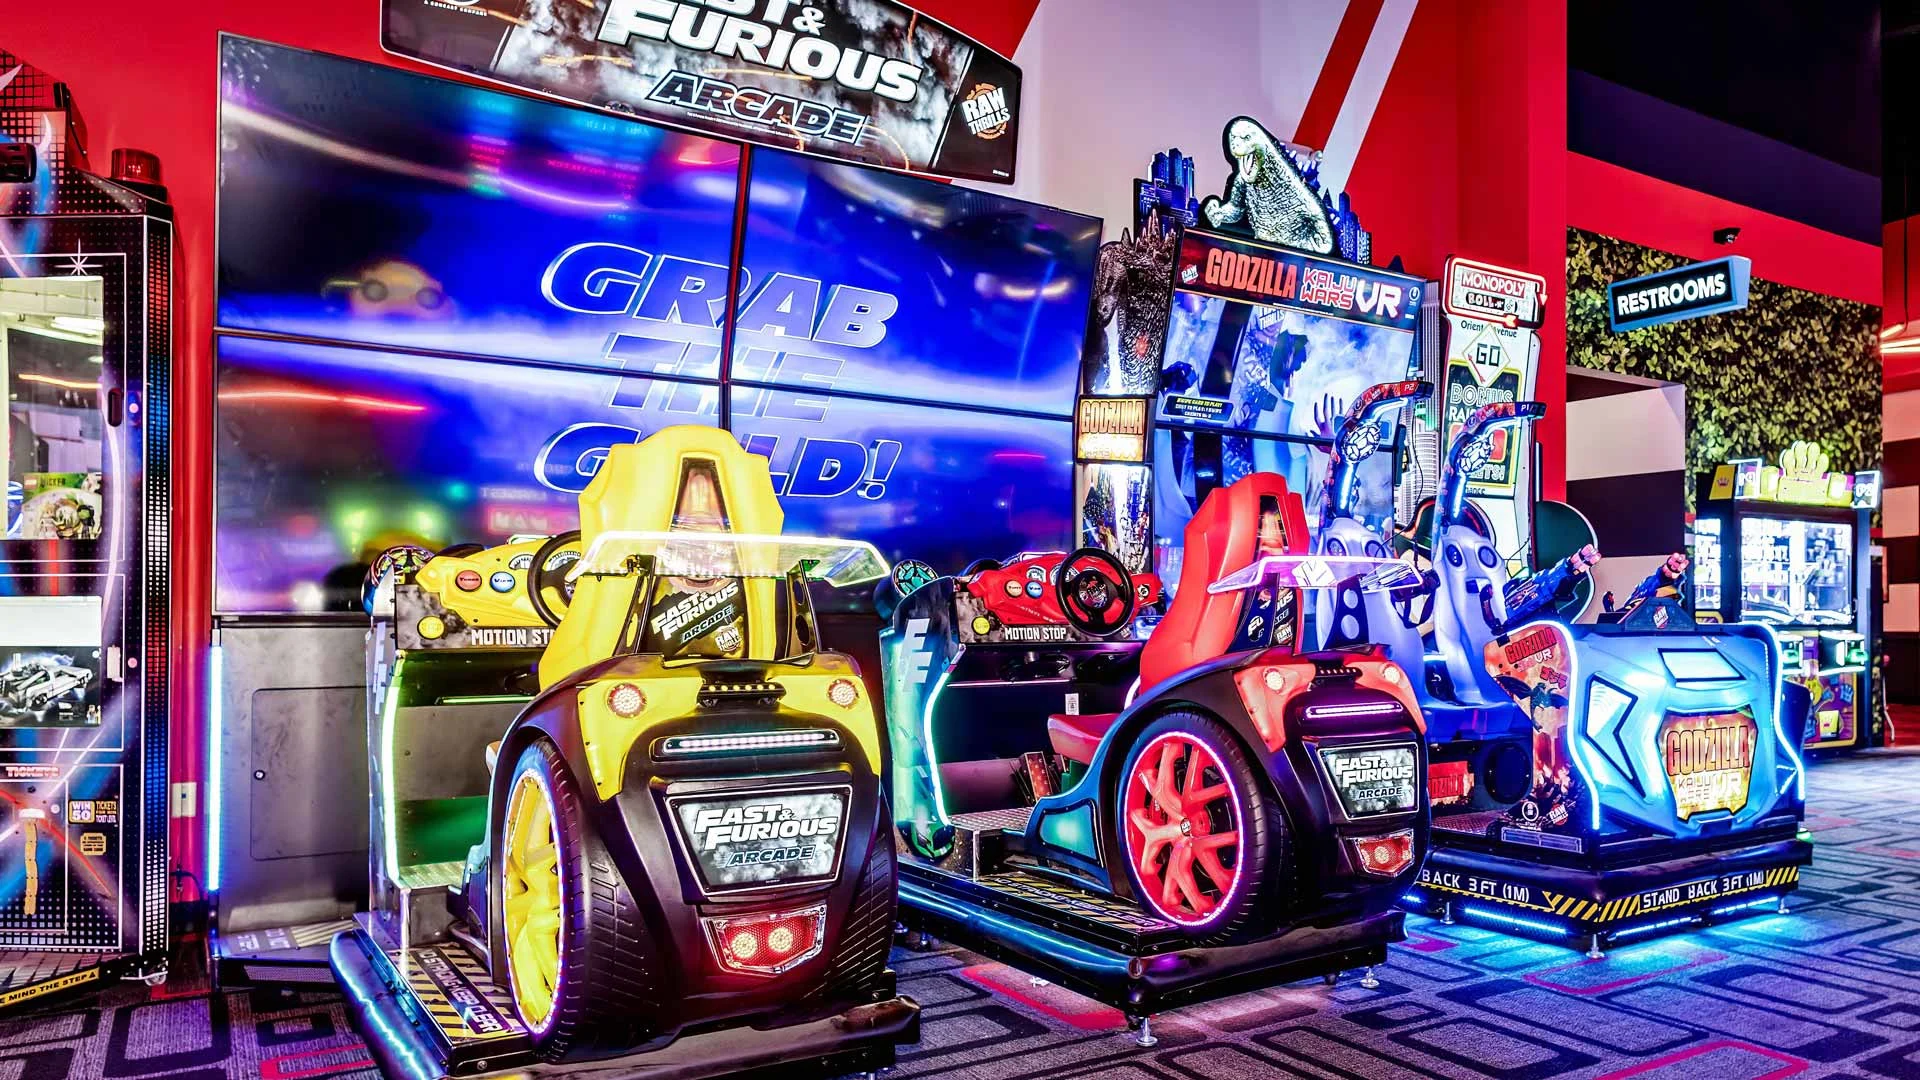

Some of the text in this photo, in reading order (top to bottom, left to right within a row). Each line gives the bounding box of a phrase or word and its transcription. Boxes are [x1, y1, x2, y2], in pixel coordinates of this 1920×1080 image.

[597, 0, 922, 103] FURIOUS
[648, 71, 866, 145] ARCADE
[962, 87, 1006, 122] RAW
[967, 107, 1011, 135] THRILLS
[1205, 247, 1298, 299] GODZILLA
[1303, 267, 1357, 294] KAIJU
[1462, 270, 1526, 298] MONOPOLY
[541, 242, 898, 348] GRAB
[1300, 285, 1354, 311] WARS
[1356, 280, 1403, 318] VR
[1617, 273, 1727, 316] RESTROOMS
[1460, 319, 1518, 338] Orient venue
[1476, 342, 1500, 367] GO
[604, 332, 846, 423] THE
[1081, 400, 1144, 435] GODZILLA
[533, 422, 903, 500] GLD!
[650, 591, 701, 635] FAST
[661, 581, 739, 641] FURIOUS
[680, 604, 736, 644] ARCADE
[471, 628, 555, 646] MOTION ST
[1004, 627, 1067, 641] MOTION STOP
[1505, 626, 1558, 665] GODZILLA
[1335, 755, 1381, 776] FAST
[1666, 725, 1751, 777] GODZILLA
[1342, 765, 1413, 788] FURIOUS
[1358, 786, 1403, 799] ARCADE
[72, 810, 91, 820] 50
[694, 803, 783, 834] FAST
[704, 816, 839, 851] FURIOUS
[726, 845, 816, 868] ARCADE
[1422, 869, 1460, 889] BACK
[1502, 882, 1530, 903] (1M)
[1643, 887, 1680, 909] STAND
[1687, 879, 1718, 899] BACK
[8, 974, 87, 1001] MIND THE STEP
